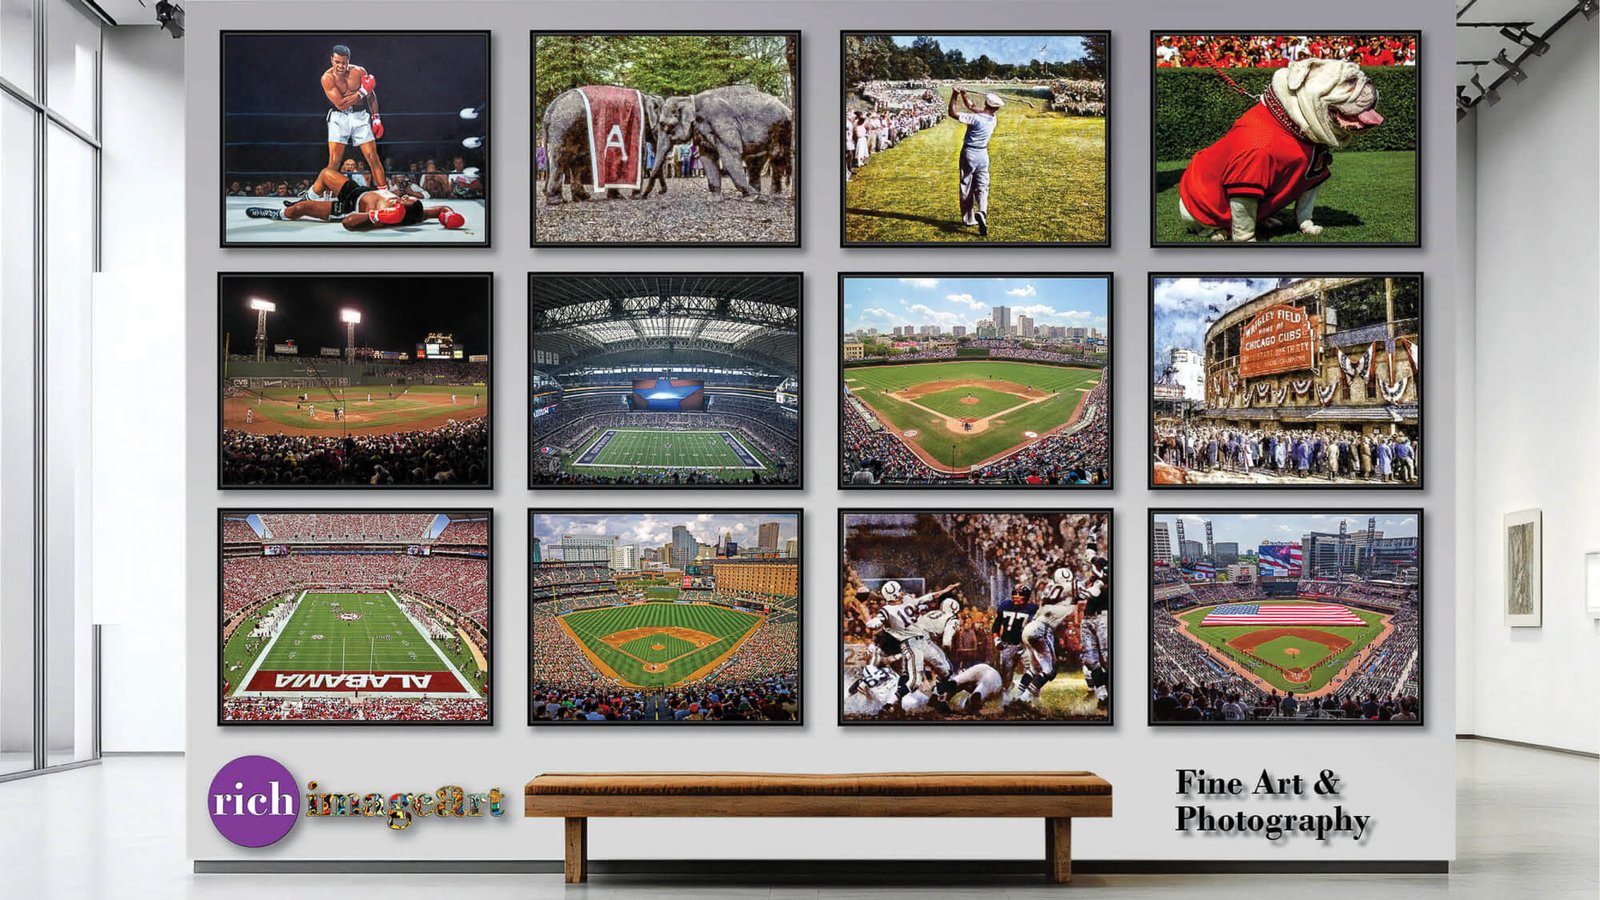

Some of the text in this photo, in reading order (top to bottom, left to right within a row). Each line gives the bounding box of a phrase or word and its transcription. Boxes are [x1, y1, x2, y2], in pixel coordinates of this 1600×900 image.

[604, 124, 628, 160] A
[1245, 309, 1301, 337] WRIGLEY FIELD
[1245, 328, 1302, 351] CHICAGO CUBS
[896, 605, 918, 628] 19
[1002, 610, 1030, 632] 77
[274, 673, 432, 689] ALABAMA
[1175, 768, 1340, 795] Fine Art &
[213, 781, 296, 816] rich
[1175, 805, 1371, 841] Photography
